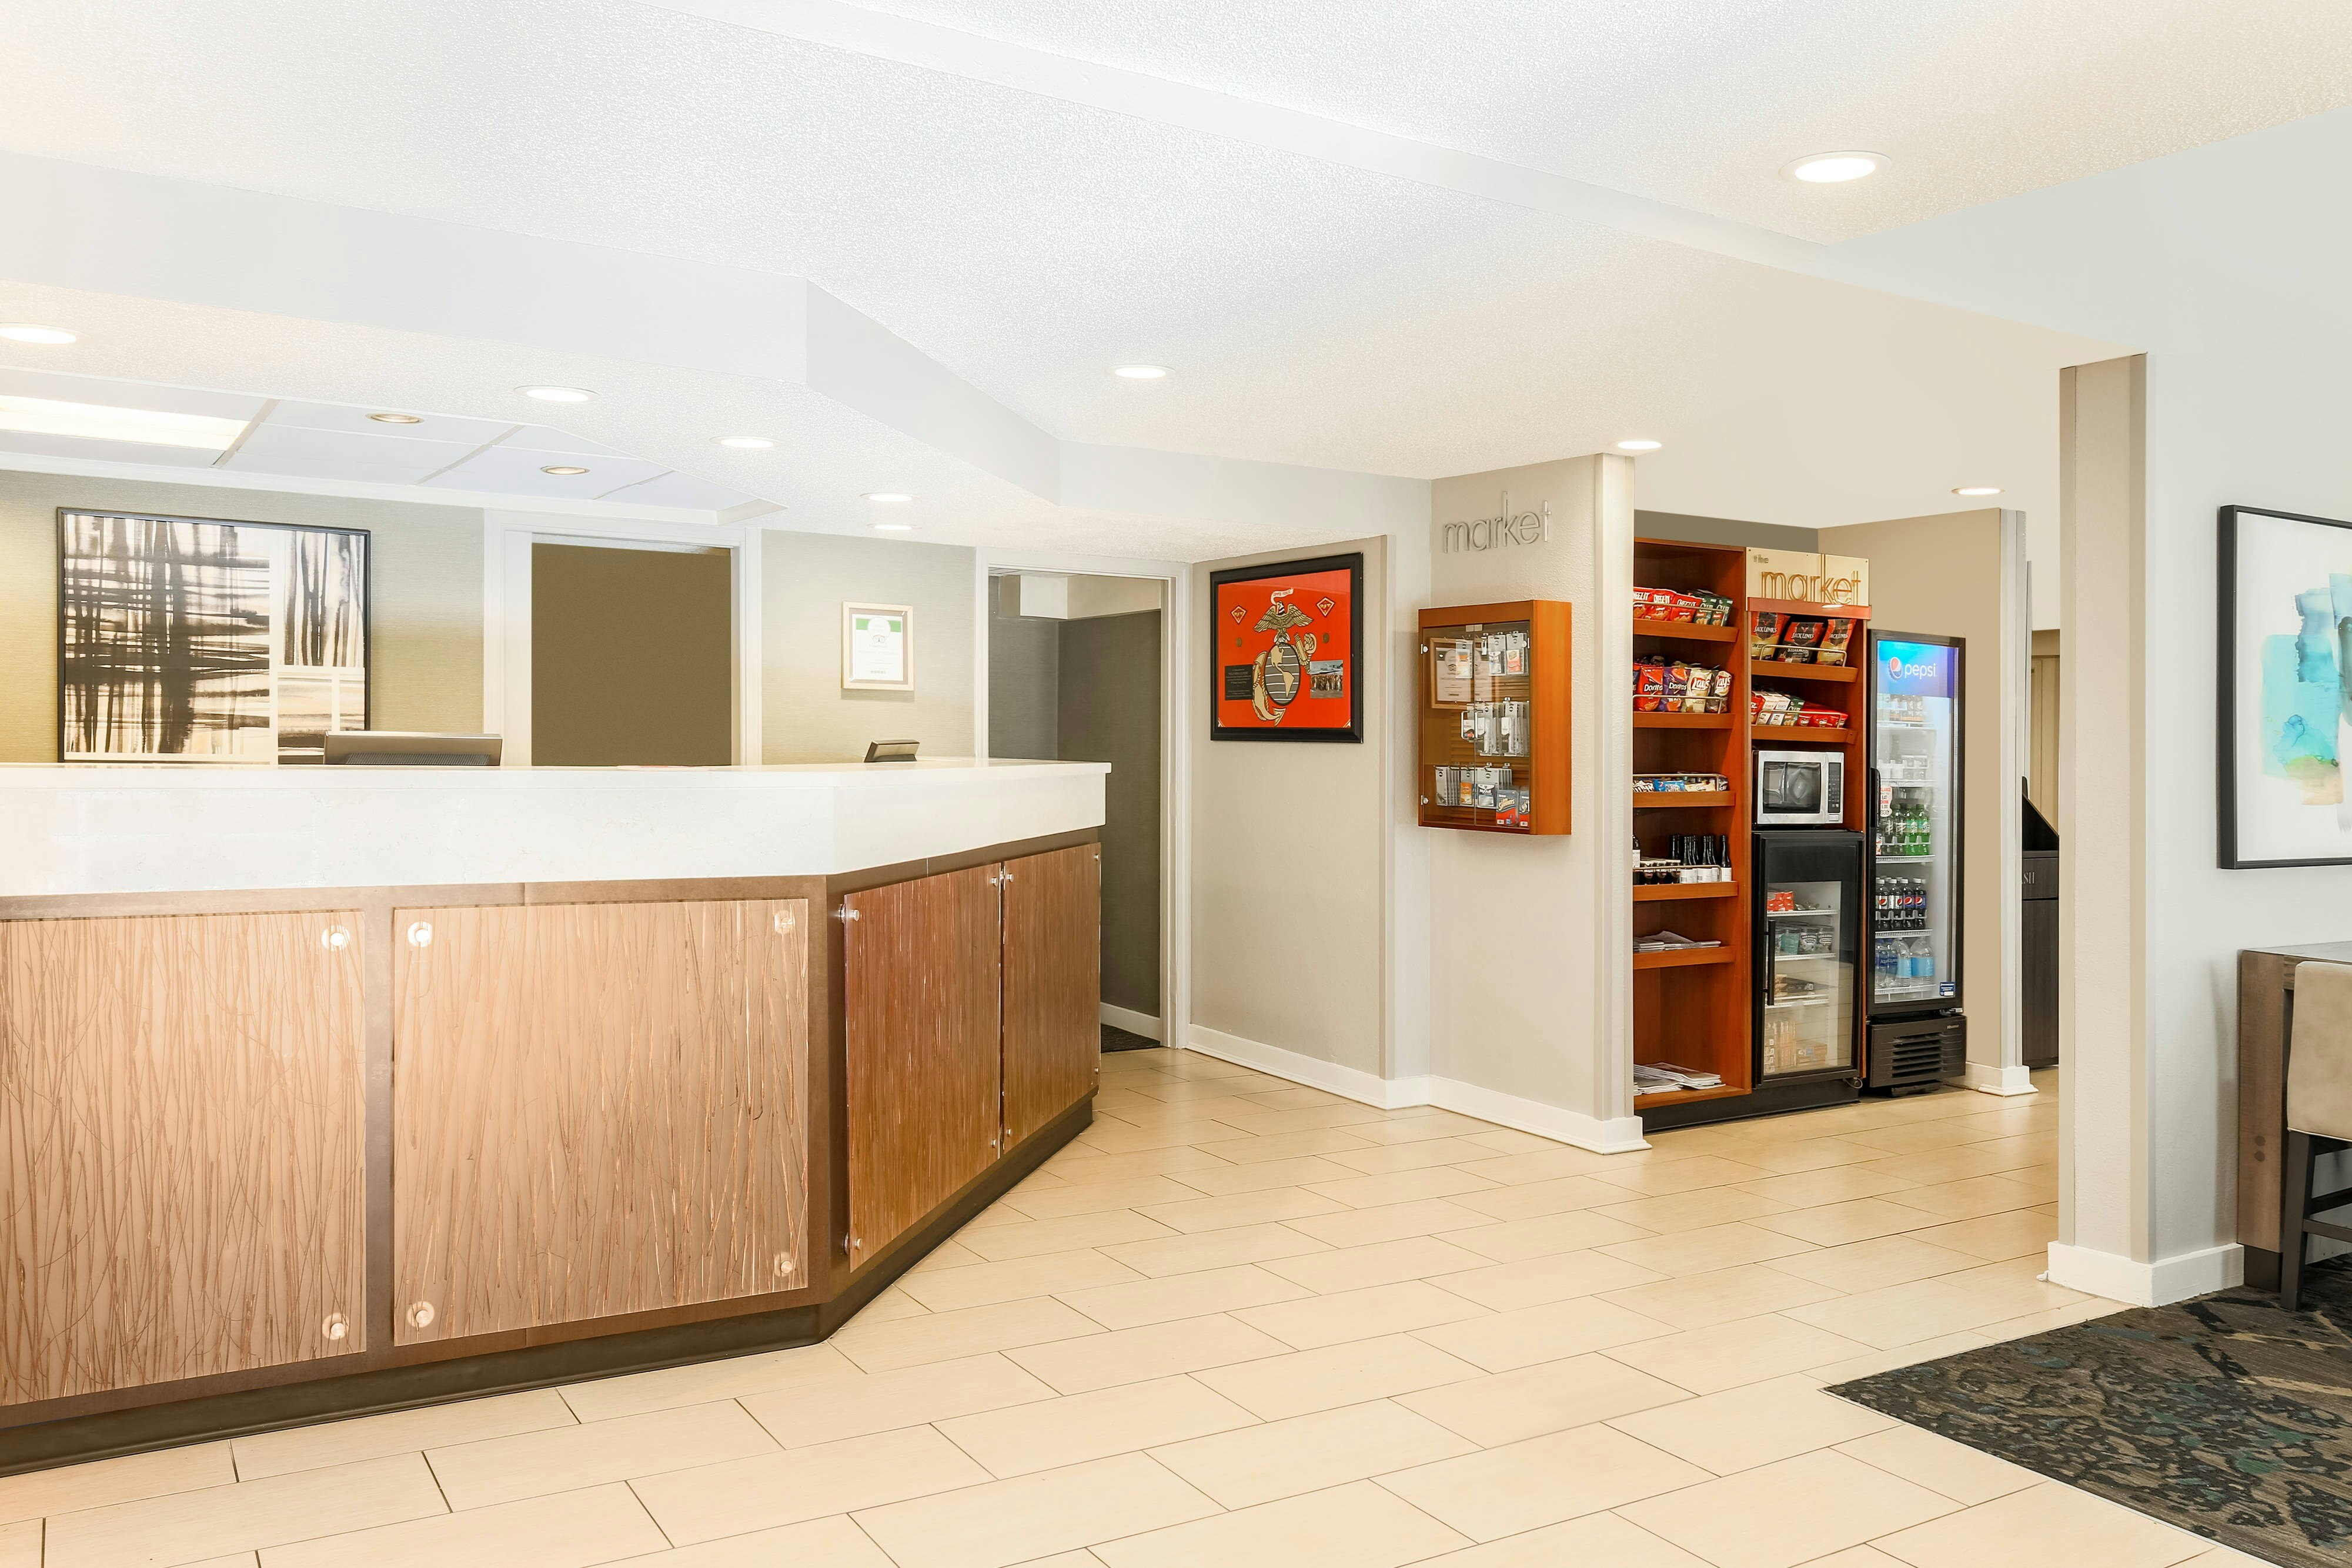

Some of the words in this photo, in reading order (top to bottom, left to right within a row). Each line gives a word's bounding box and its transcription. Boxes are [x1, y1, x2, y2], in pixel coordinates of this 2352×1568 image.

[1444, 490, 1552, 554] market
[1753, 554, 1769, 563] the
[1760, 554, 1862, 606] market
[1904, 663, 1937, 680] pepsi
[1643, 684, 1663, 692] Dorito
[2023, 872, 2035, 884] SH
